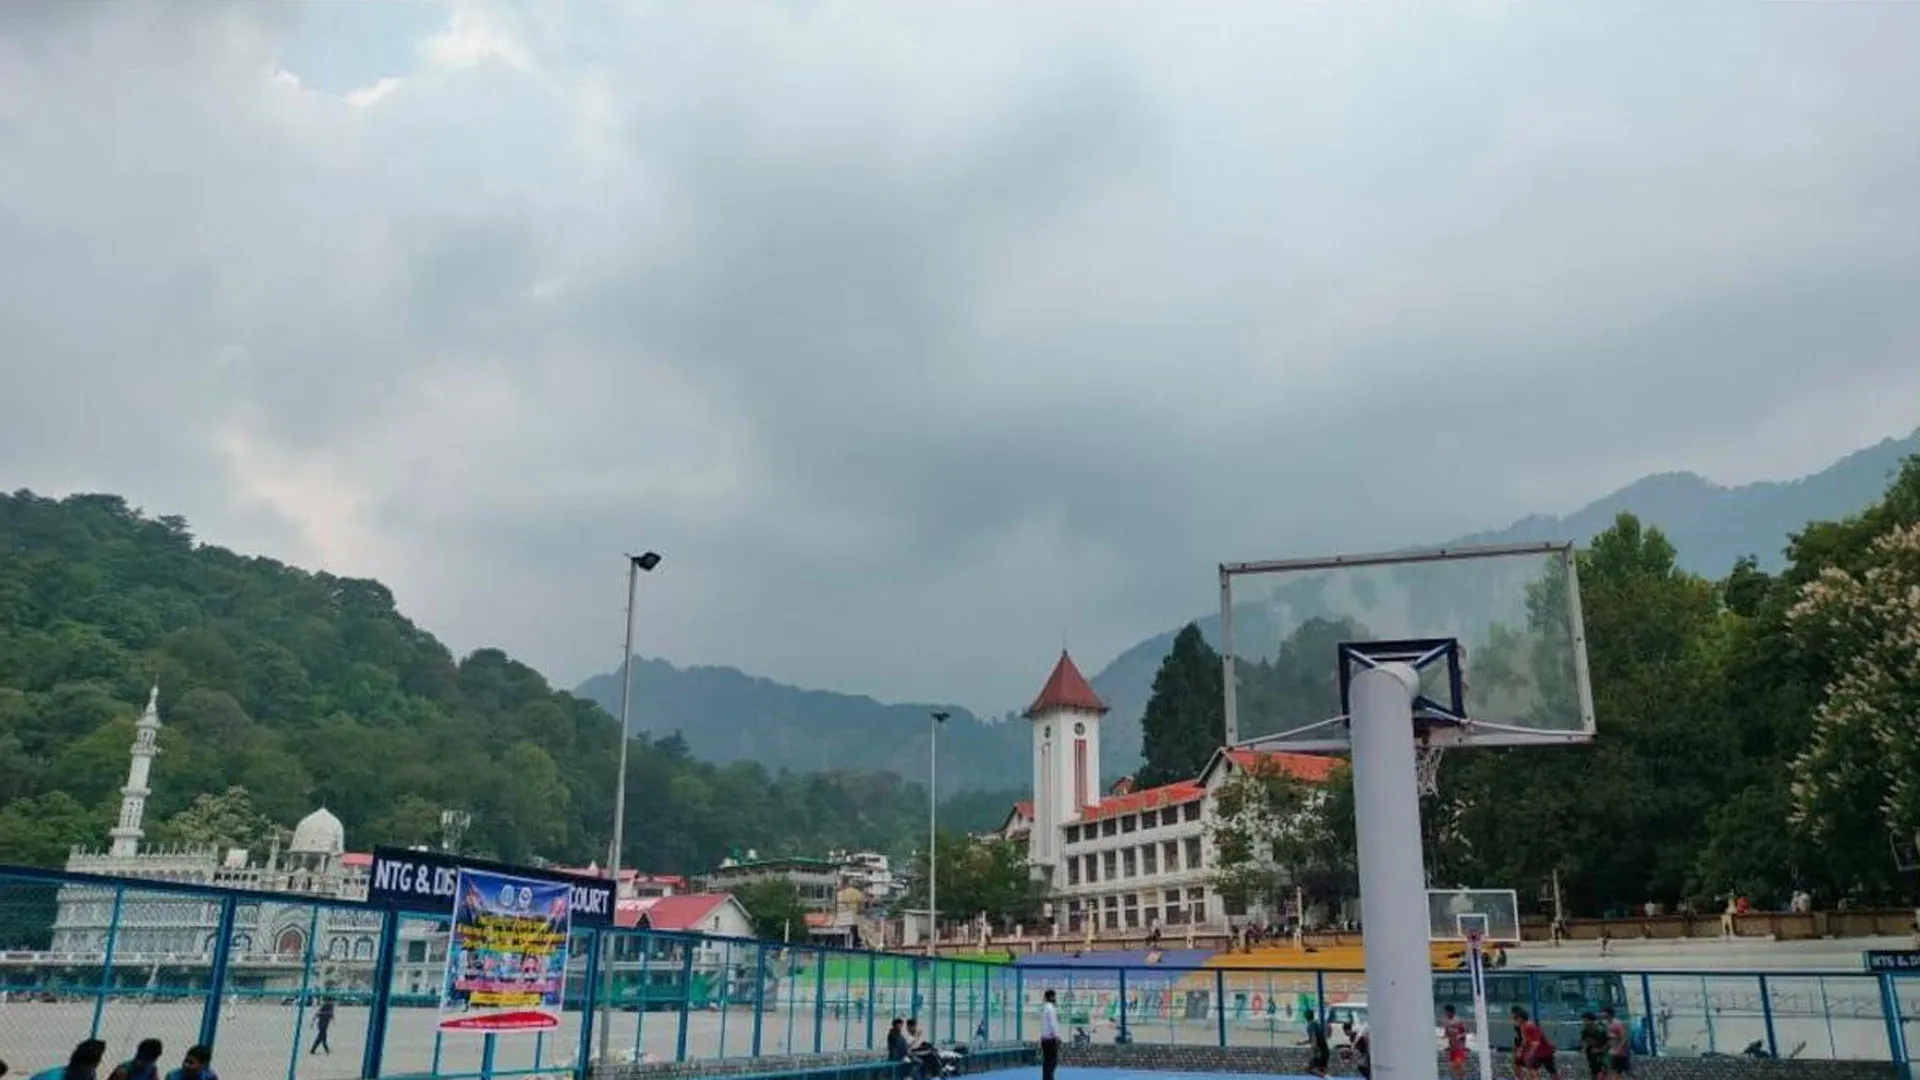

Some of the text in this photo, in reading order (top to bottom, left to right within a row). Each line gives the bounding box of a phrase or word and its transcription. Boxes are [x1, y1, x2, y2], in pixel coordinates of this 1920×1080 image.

[374, 858, 610, 914] NTG & DIS COURT
